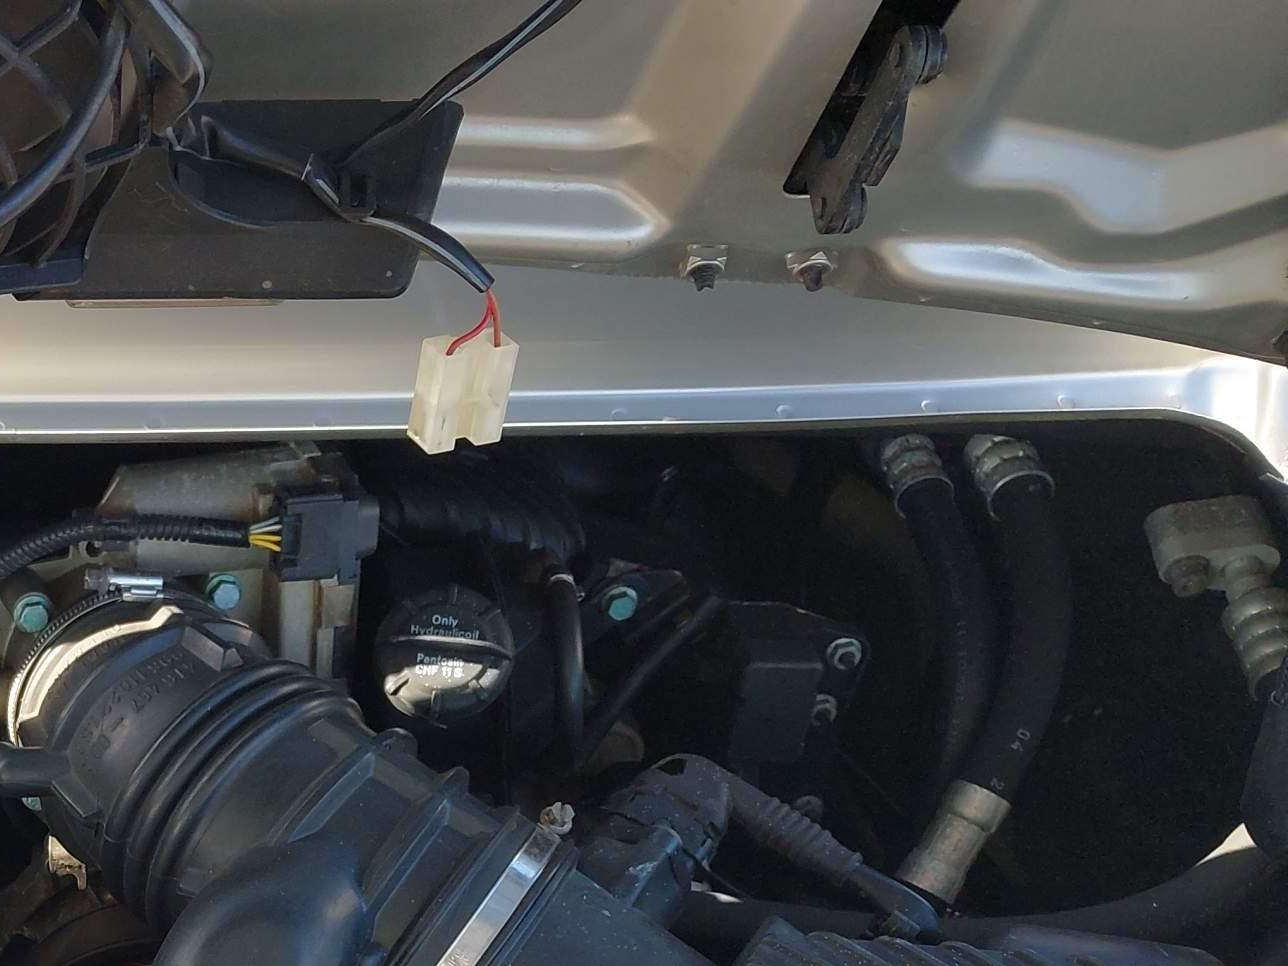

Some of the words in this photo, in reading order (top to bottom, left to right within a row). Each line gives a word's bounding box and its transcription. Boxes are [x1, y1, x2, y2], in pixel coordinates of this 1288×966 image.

[432, 614, 458, 628] Only
[416, 652, 465, 667] Pentosin
[415, 664, 439, 676] CHF
